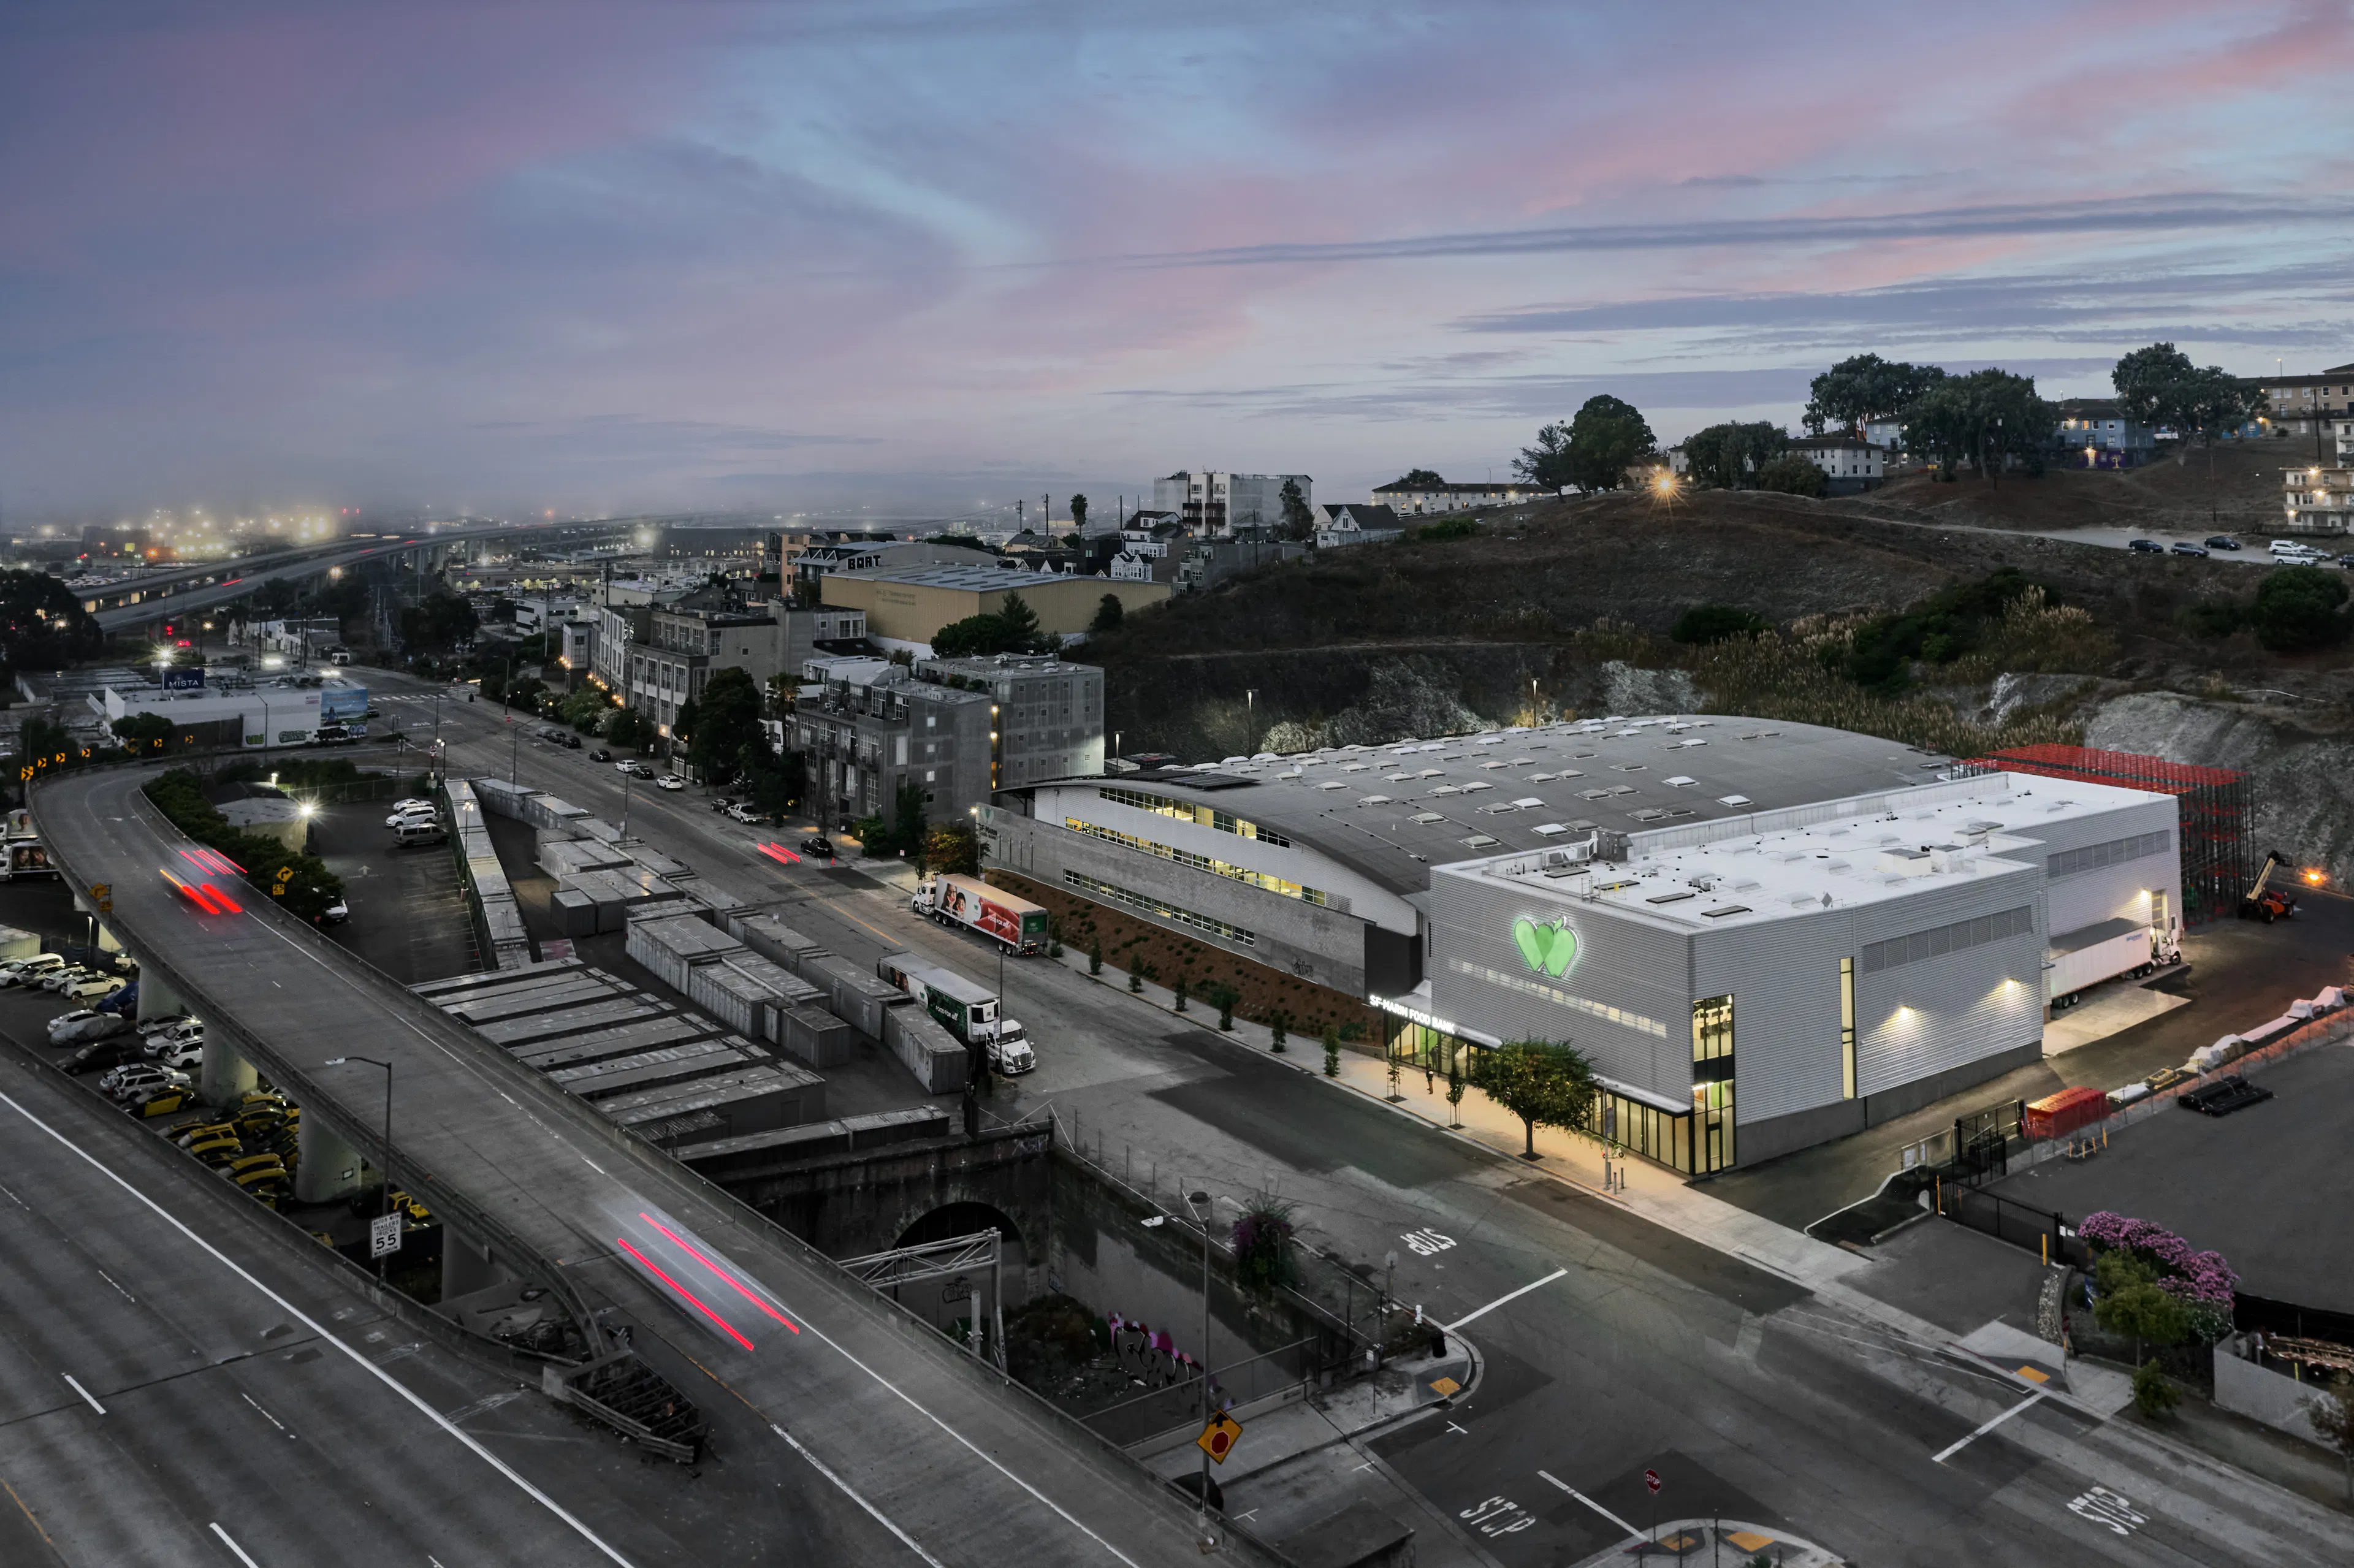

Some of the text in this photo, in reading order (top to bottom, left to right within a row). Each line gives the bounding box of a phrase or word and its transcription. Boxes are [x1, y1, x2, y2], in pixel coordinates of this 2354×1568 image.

[847, 555, 880, 569] BOAT
[935, 1005, 945, 1014] FOOD
[1369, 995, 1455, 1034] SF-MARIN FOOD BANK
[374, 1220, 398, 1231] TRAILERS
[376, 1227, 397, 1237] TRUCKS
[376, 1233, 396, 1249] 55
[1400, 1227, 1457, 1255] STOP
[374, 1245, 398, 1255] MAXIMUM
[1646, 1474, 1660, 1486] STOP
[1460, 1496, 1536, 1537] STOP
[2066, 1486, 2150, 1535] STOP
